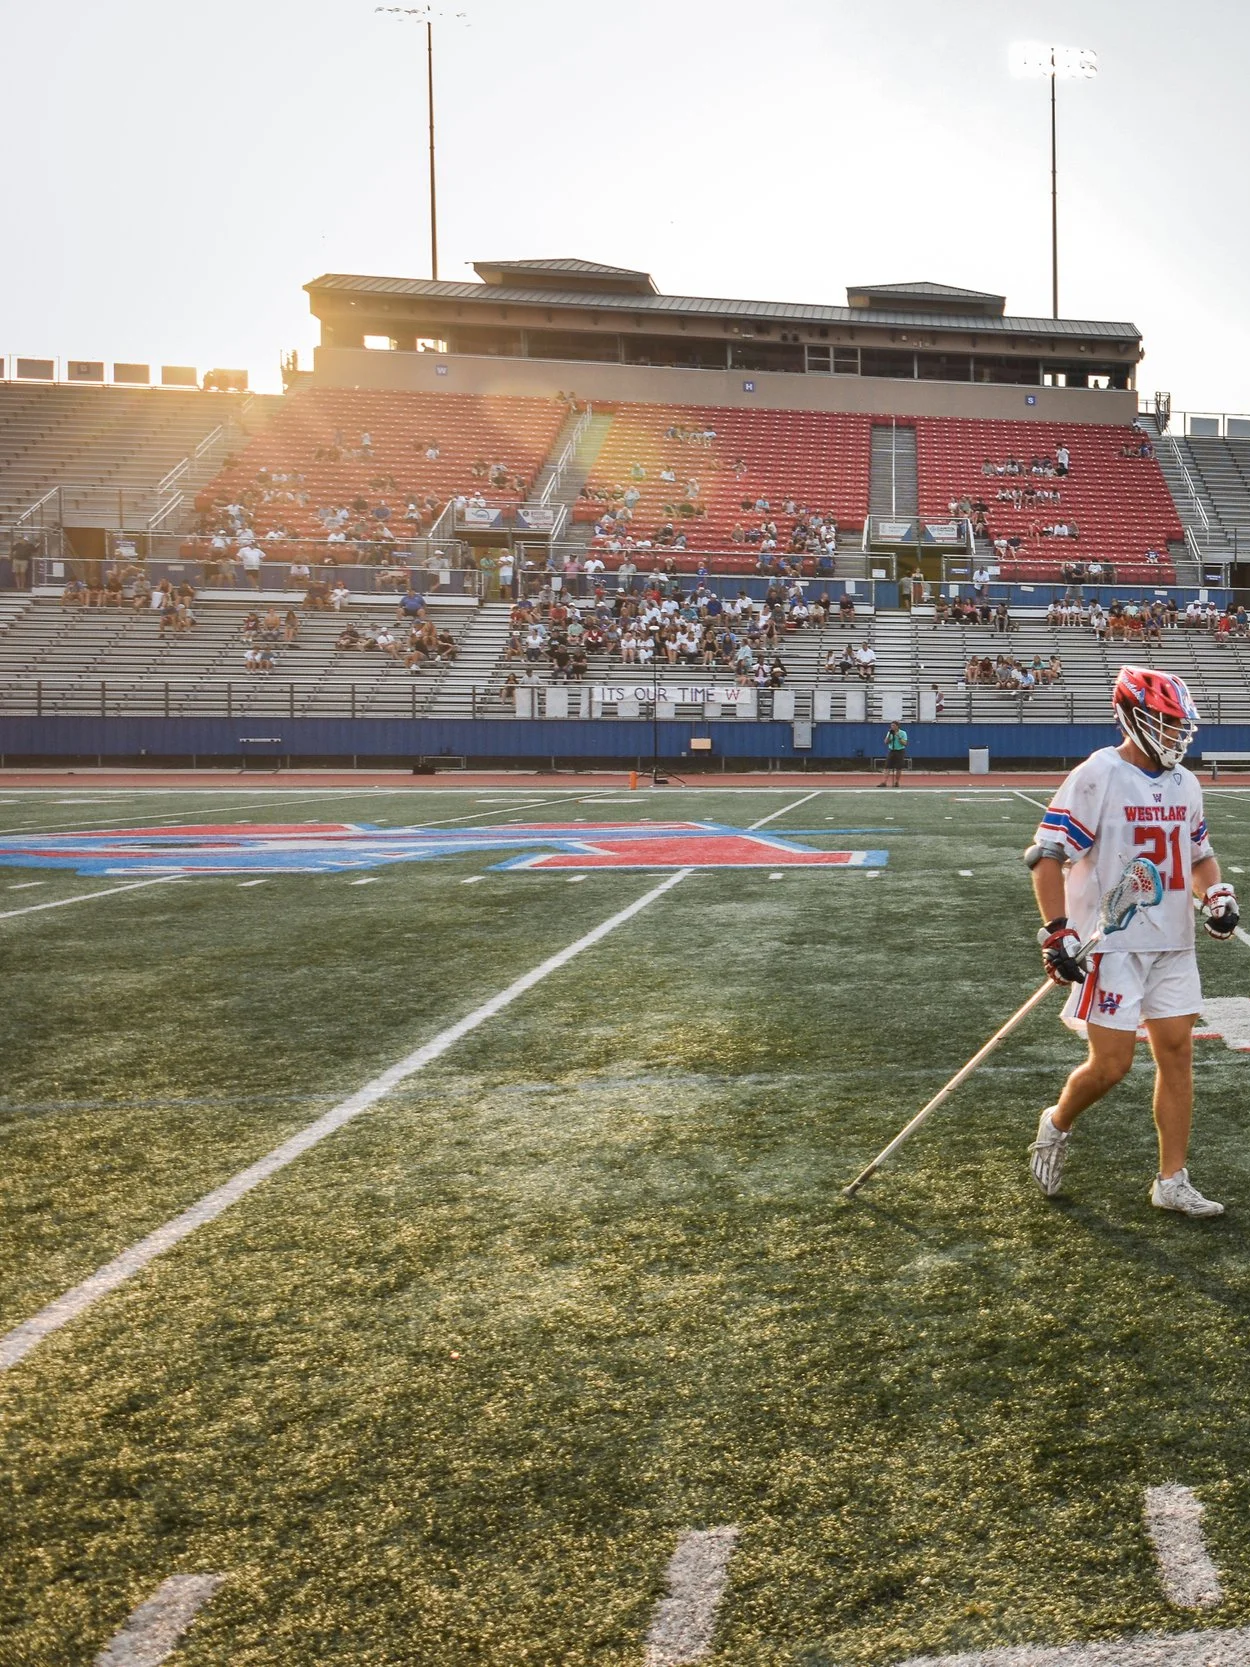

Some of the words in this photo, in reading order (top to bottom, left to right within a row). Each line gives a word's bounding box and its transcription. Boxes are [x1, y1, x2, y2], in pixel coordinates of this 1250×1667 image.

[601, 687, 625, 701] ITS
[634, 687, 668, 702] OUR
[677, 687, 716, 702] TIME
[725, 688, 741, 701] W
[1152, 793, 1162, 803] W
[1123, 806, 1187, 822] WESTLAKE
[1133, 826, 1185, 891] 21
[1098, 989, 1124, 1016] W
